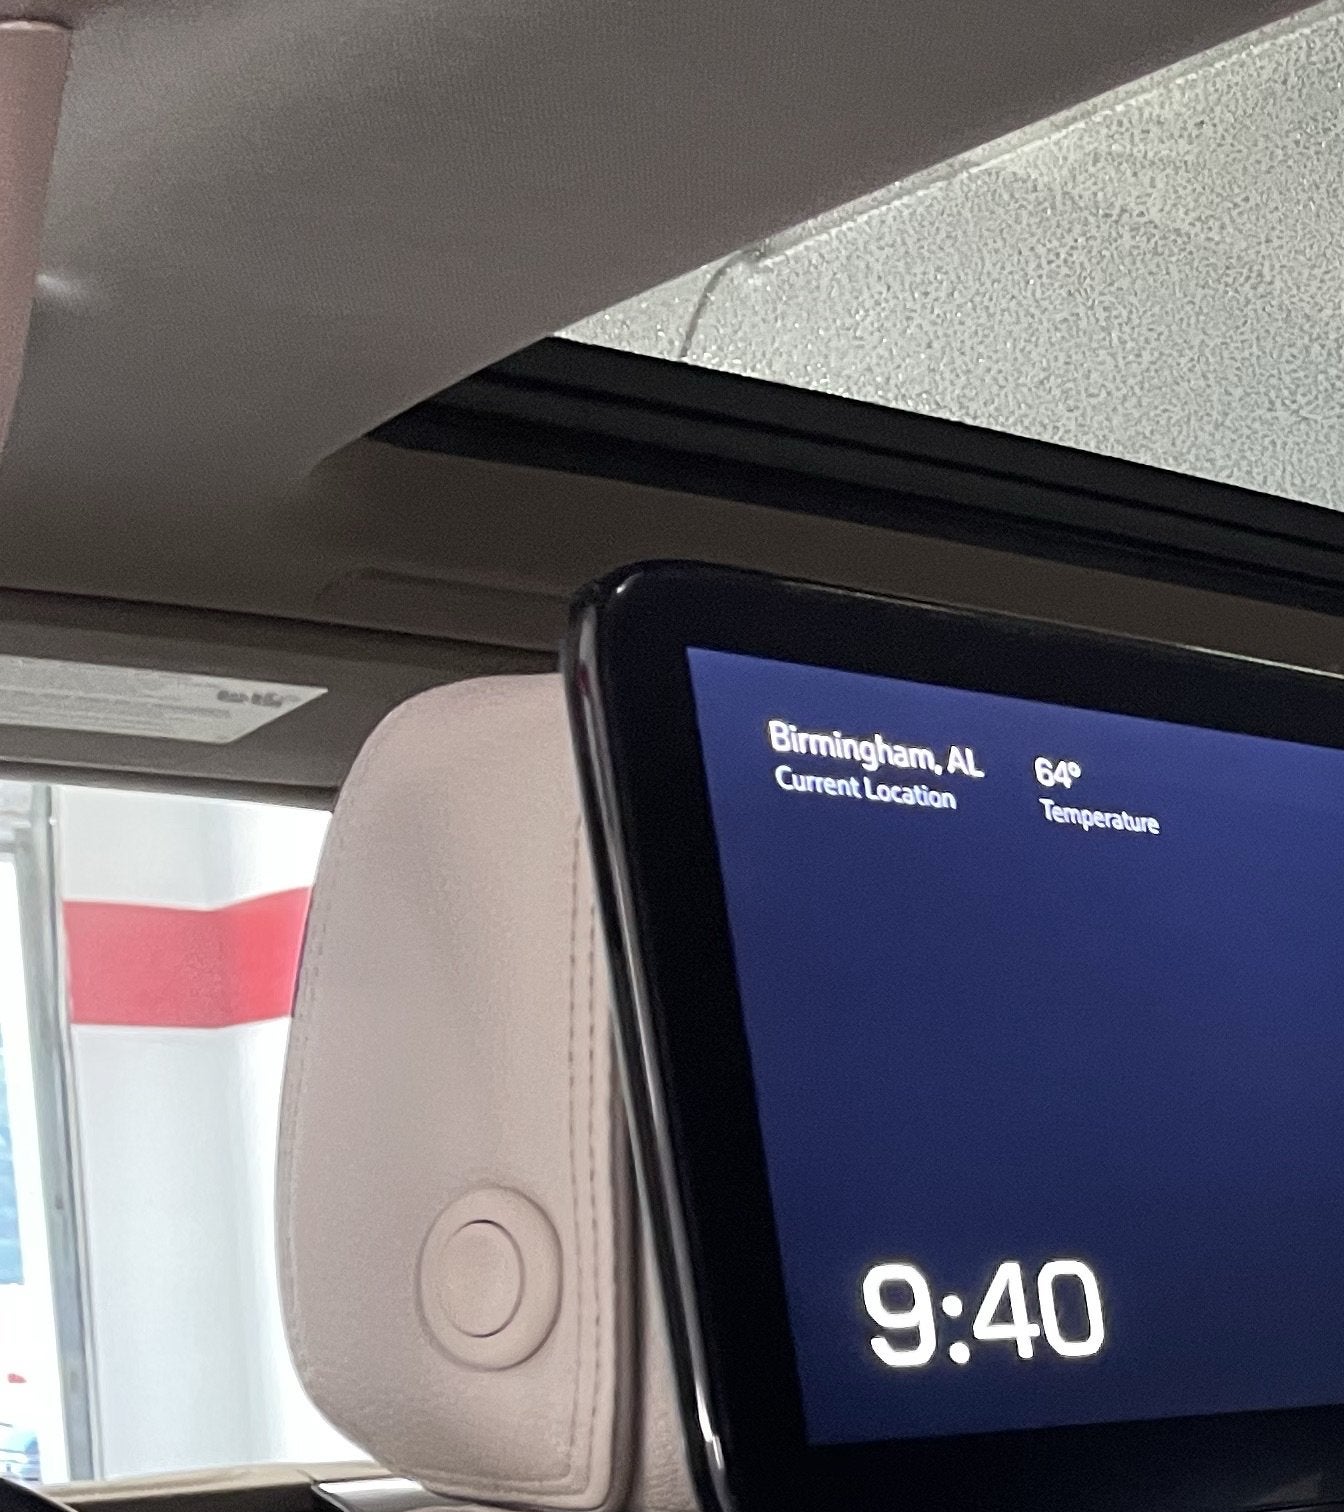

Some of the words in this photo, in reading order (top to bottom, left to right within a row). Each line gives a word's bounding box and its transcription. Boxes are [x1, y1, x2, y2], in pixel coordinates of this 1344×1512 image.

[768, 720, 943, 776] Birmingham,
[946, 746, 985, 779] AL
[775, 765, 861, 800] Current
[865, 777, 957, 811] Location
[1039, 797, 1161, 836] Temperature
[862, 1259, 1105, 1368] 9:40
